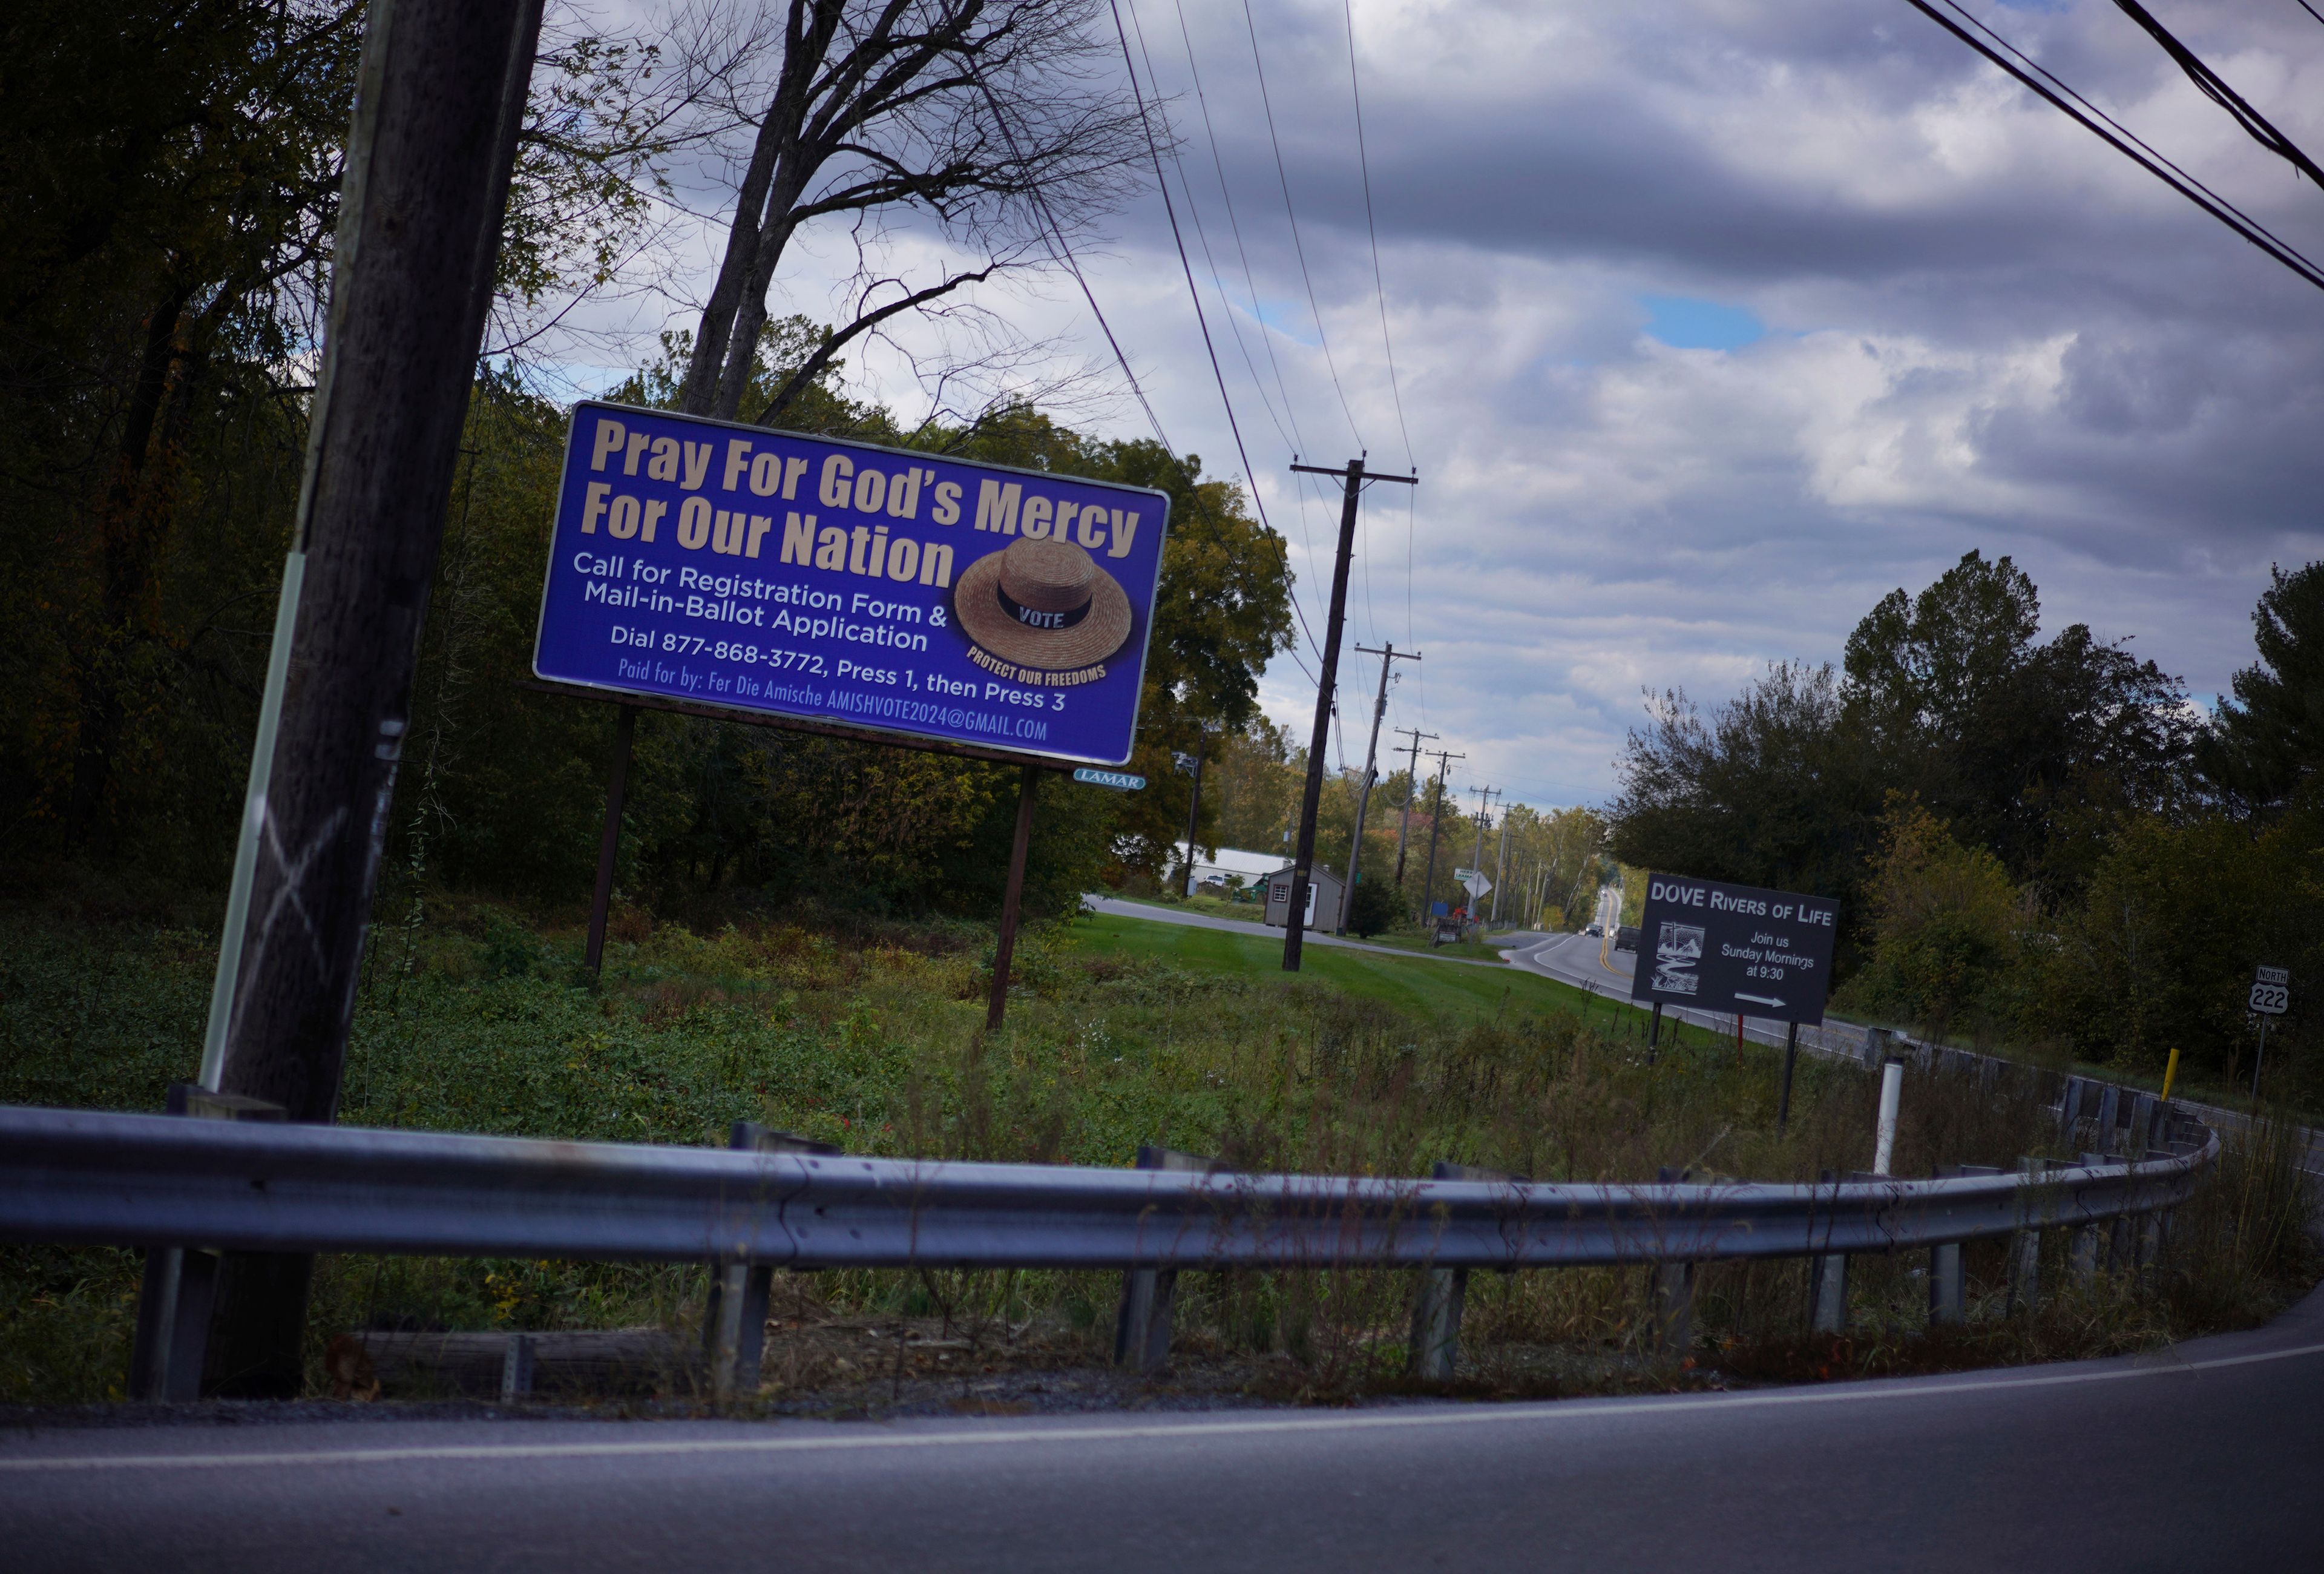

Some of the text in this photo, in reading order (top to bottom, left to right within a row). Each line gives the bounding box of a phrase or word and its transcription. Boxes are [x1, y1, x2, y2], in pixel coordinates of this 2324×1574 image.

[591, 419, 1140, 558] Pray For God's Mercy
[581, 481, 954, 588] For Our Nation
[573, 552, 948, 628] Call for Registration Form &
[585, 581, 928, 652] Mail-in-Ballot Application
[1019, 606, 1065, 628] VOTE
[611, 626, 1066, 711] Dial 877-868-3772, Press 1, then Press 3
[966, 645, 1107, 687] PROTECT OUR FREEDOMS
[618, 658, 1047, 740] Paid for by: Fer Die Amische AMISHVOTE2024@GMAIL.COM
[1080, 771, 1139, 788] LAMAR
[1651, 882, 1705, 907] DOVE
[1751, 931, 1789, 948] Join us
[1721, 944, 1814, 970] Sunday Mornings
[1747, 966, 1784, 981] at 9:30
[2259, 969, 2286, 982] NORTH
[2253, 988, 2285, 1009] 222
